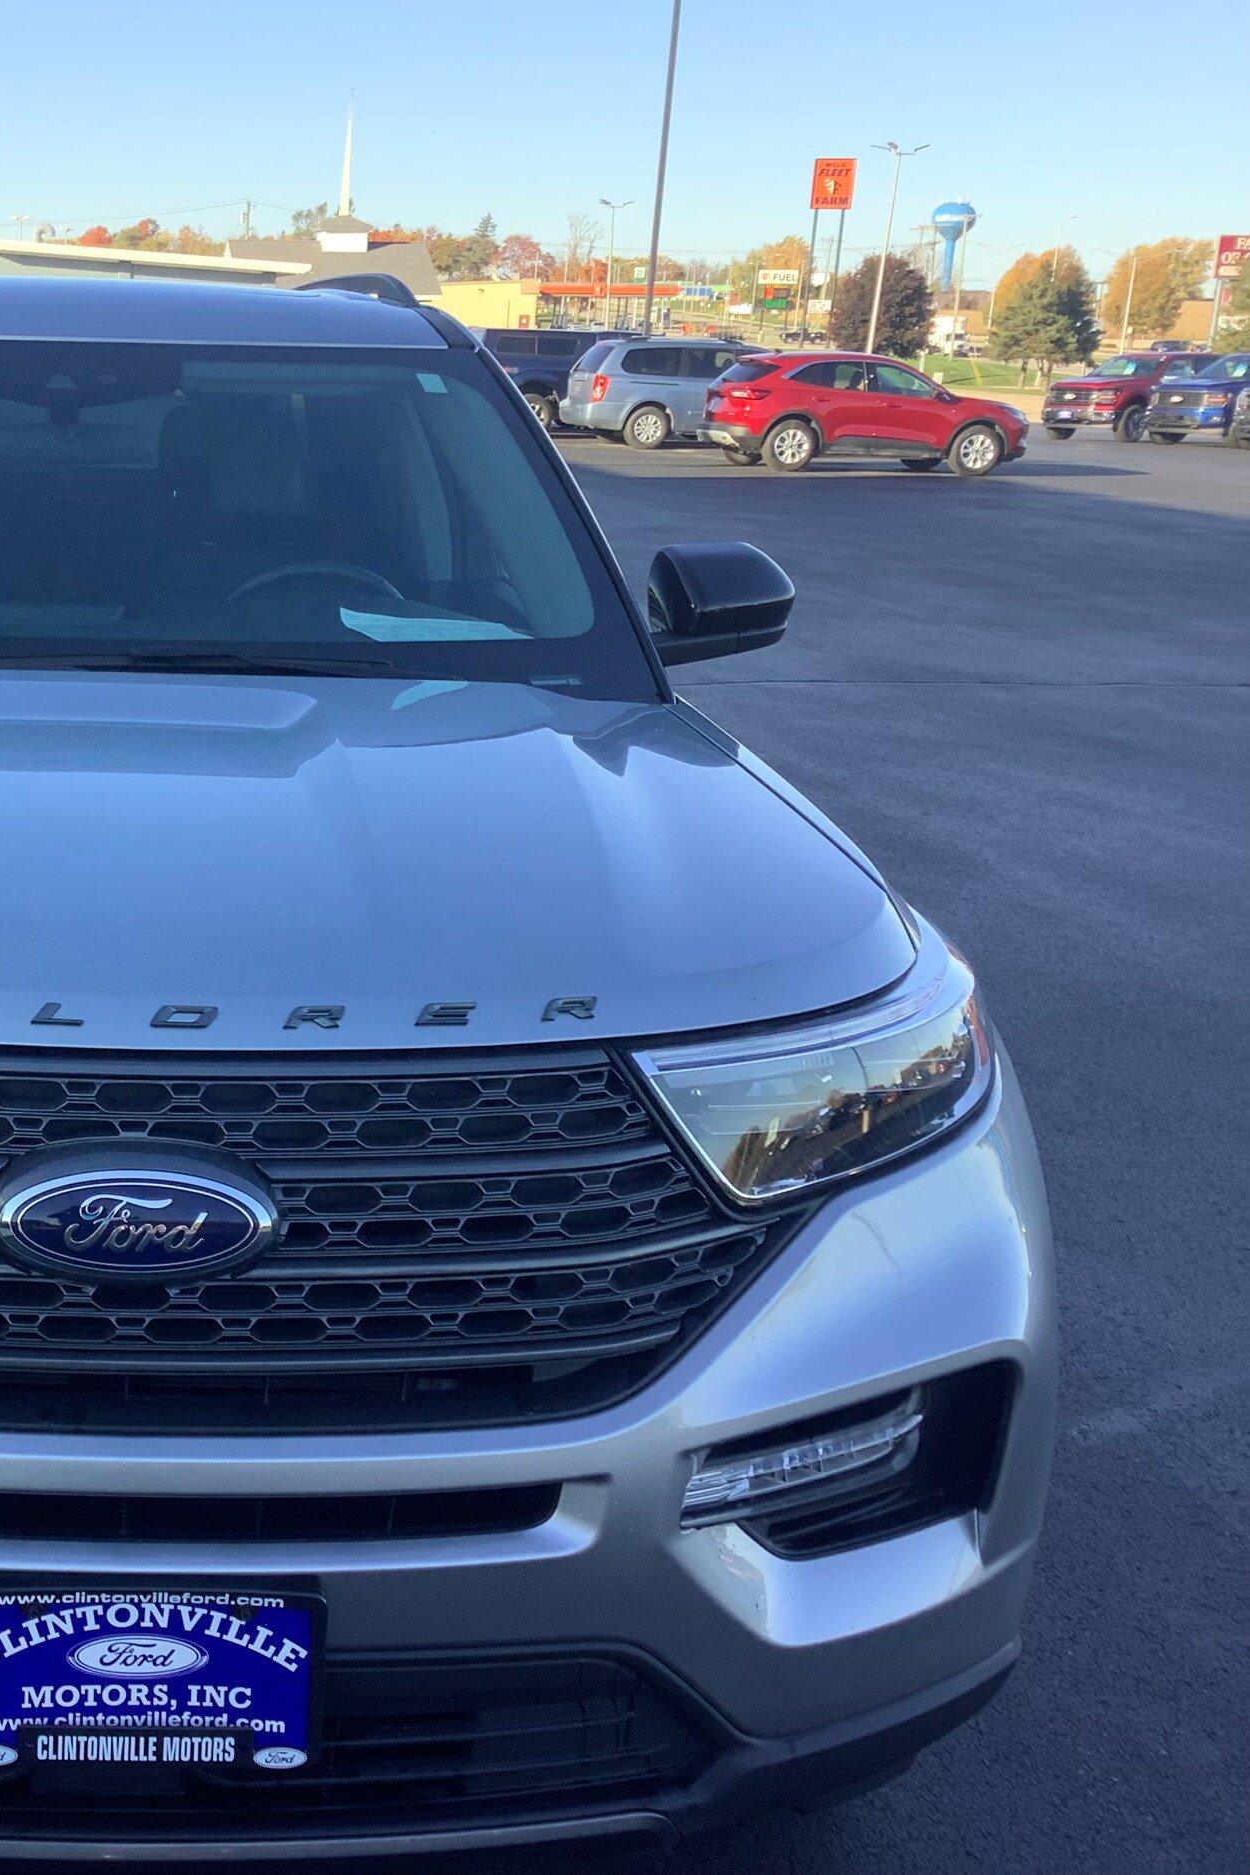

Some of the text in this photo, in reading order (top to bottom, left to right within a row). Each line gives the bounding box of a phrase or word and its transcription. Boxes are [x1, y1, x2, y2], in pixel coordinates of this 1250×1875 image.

[818, 168, 852, 177] FLEET
[814, 196, 849, 205] FARM
[772, 273, 798, 282] FUEL
[64, 1194, 208, 1252] Ford
[99, 1641, 176, 1667] Ford
[21, 1684, 252, 1711] MOTORS, INC
[36, 1735, 236, 1763] CLINTONVILLE MOTORS
[264, 1751, 296, 1765] Ford
